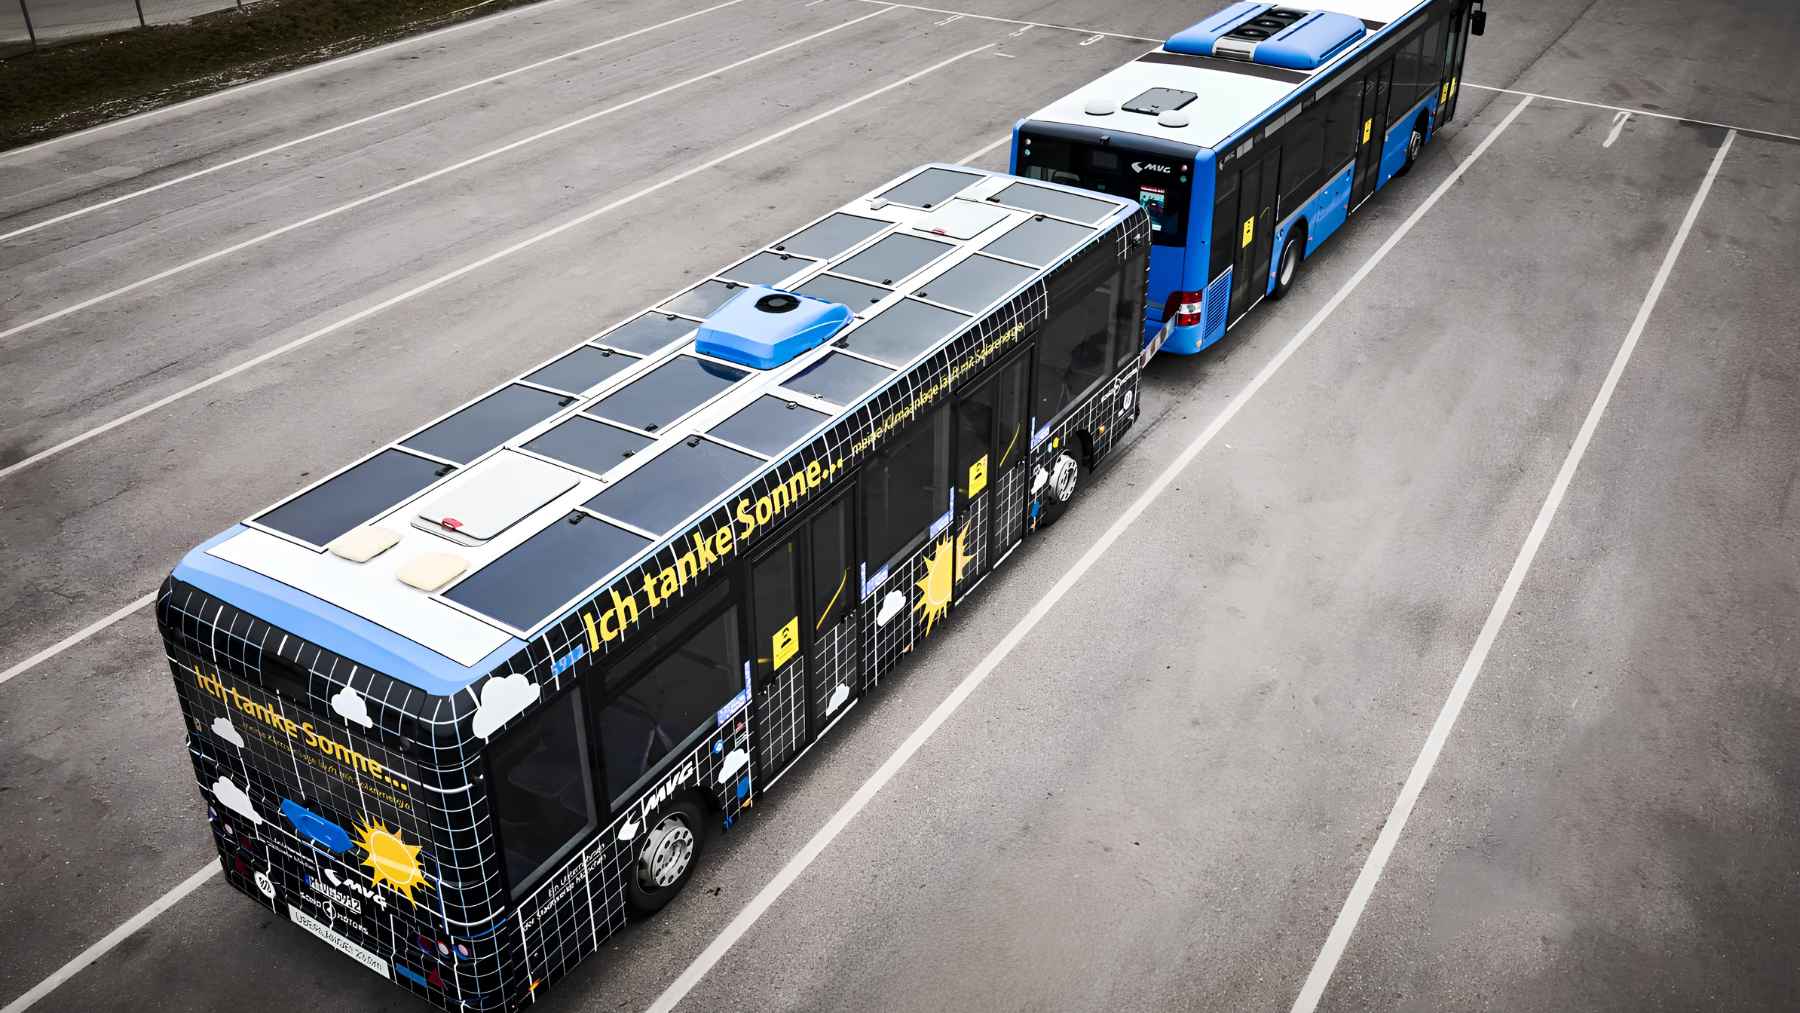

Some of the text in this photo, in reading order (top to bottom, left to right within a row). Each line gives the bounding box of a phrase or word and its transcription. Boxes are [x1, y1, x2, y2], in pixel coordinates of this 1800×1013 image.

[1143, 163, 1171, 174] MVG
[583, 458, 843, 652] Ich tanke Sonne...
[195, 665, 228, 704] Ich
[231, 687, 299, 739] tanke
[299, 721, 408, 791] Sonne...
[643, 760, 693, 817] MVG
[343, 878, 387, 909] MVG
